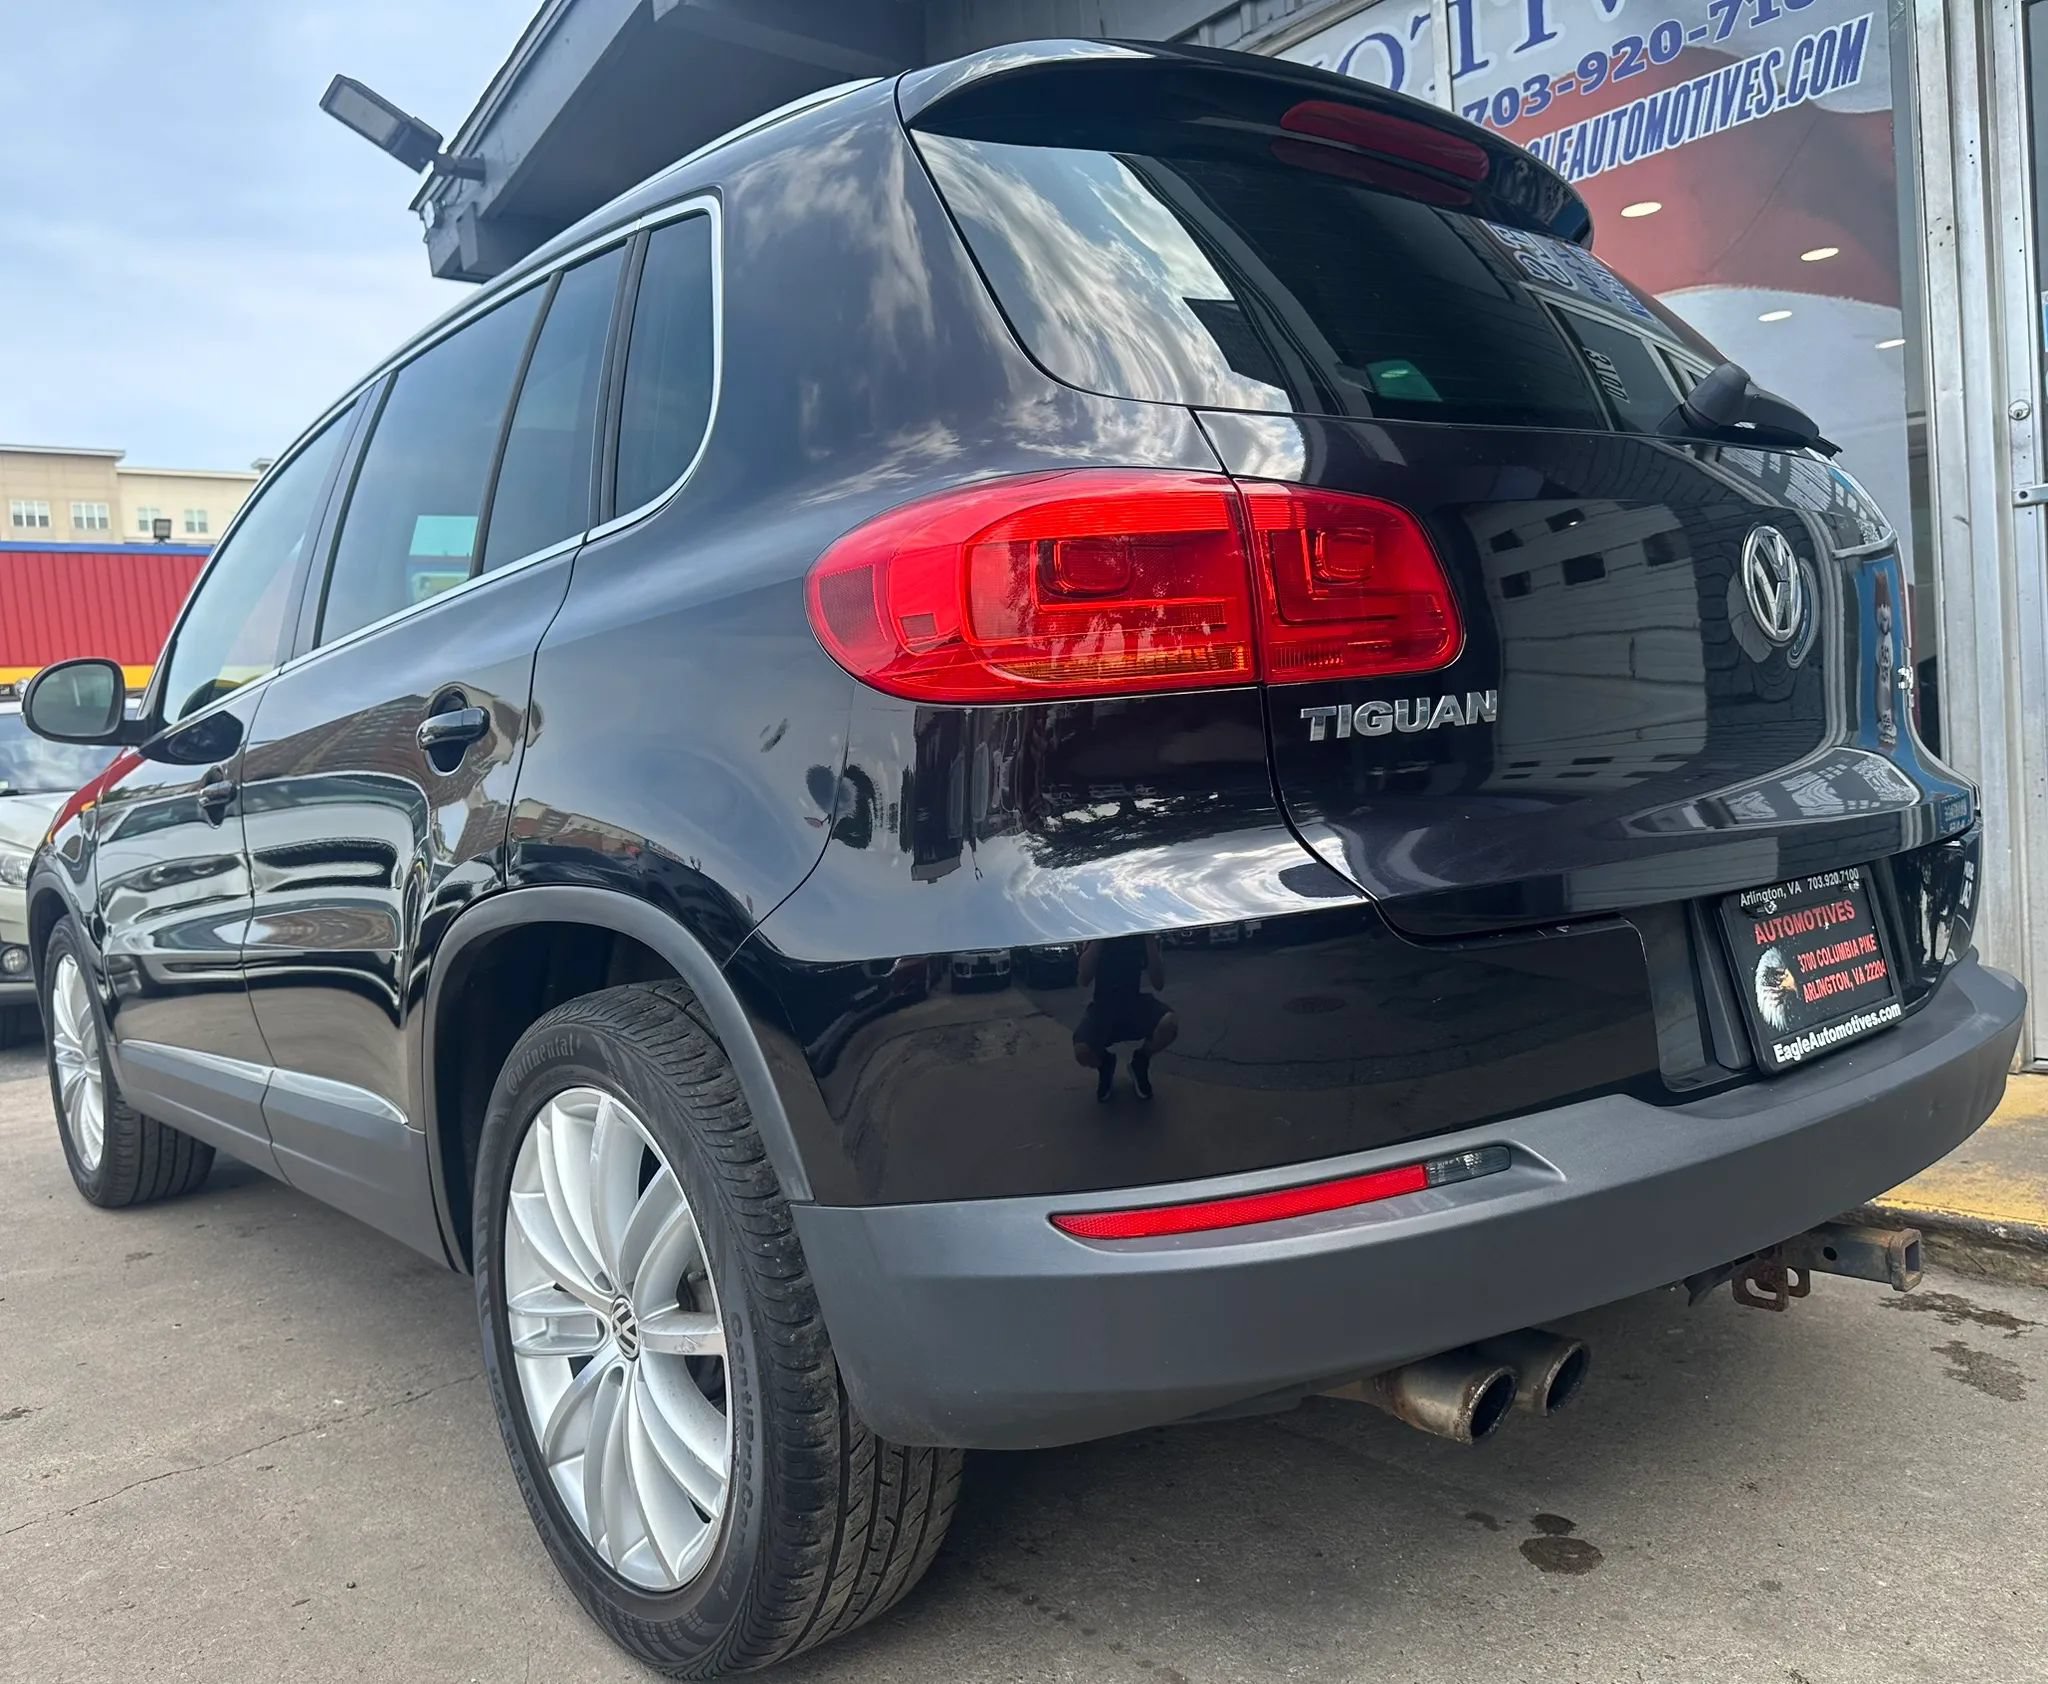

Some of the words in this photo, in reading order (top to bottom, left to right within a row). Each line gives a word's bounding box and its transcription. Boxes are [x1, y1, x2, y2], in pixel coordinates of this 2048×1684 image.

[1462, 0, 1816, 129] 703-920-71
[1301, 690, 1498, 742] TIGUAN
[1740, 886, 1787, 908] Arlington,
[1787, 880, 1802, 896] VA
[1807, 867, 1860, 891] 703.920.7100
[1754, 899, 1856, 945] AUTOMOTIVES
[1797, 951, 1818, 974] 3700
[1815, 939, 1861, 967] COLUMBIA
[1858, 933, 1878, 954] PIKE
[1802, 969, 1855, 1004] ARLINGTON,
[1851, 966, 1866, 986] VA
[1864, 958, 1888, 981] 22204
[1772, 1003, 1902, 1063] EagleAutomotives.com
[506, 1032, 575, 1097] Continental
